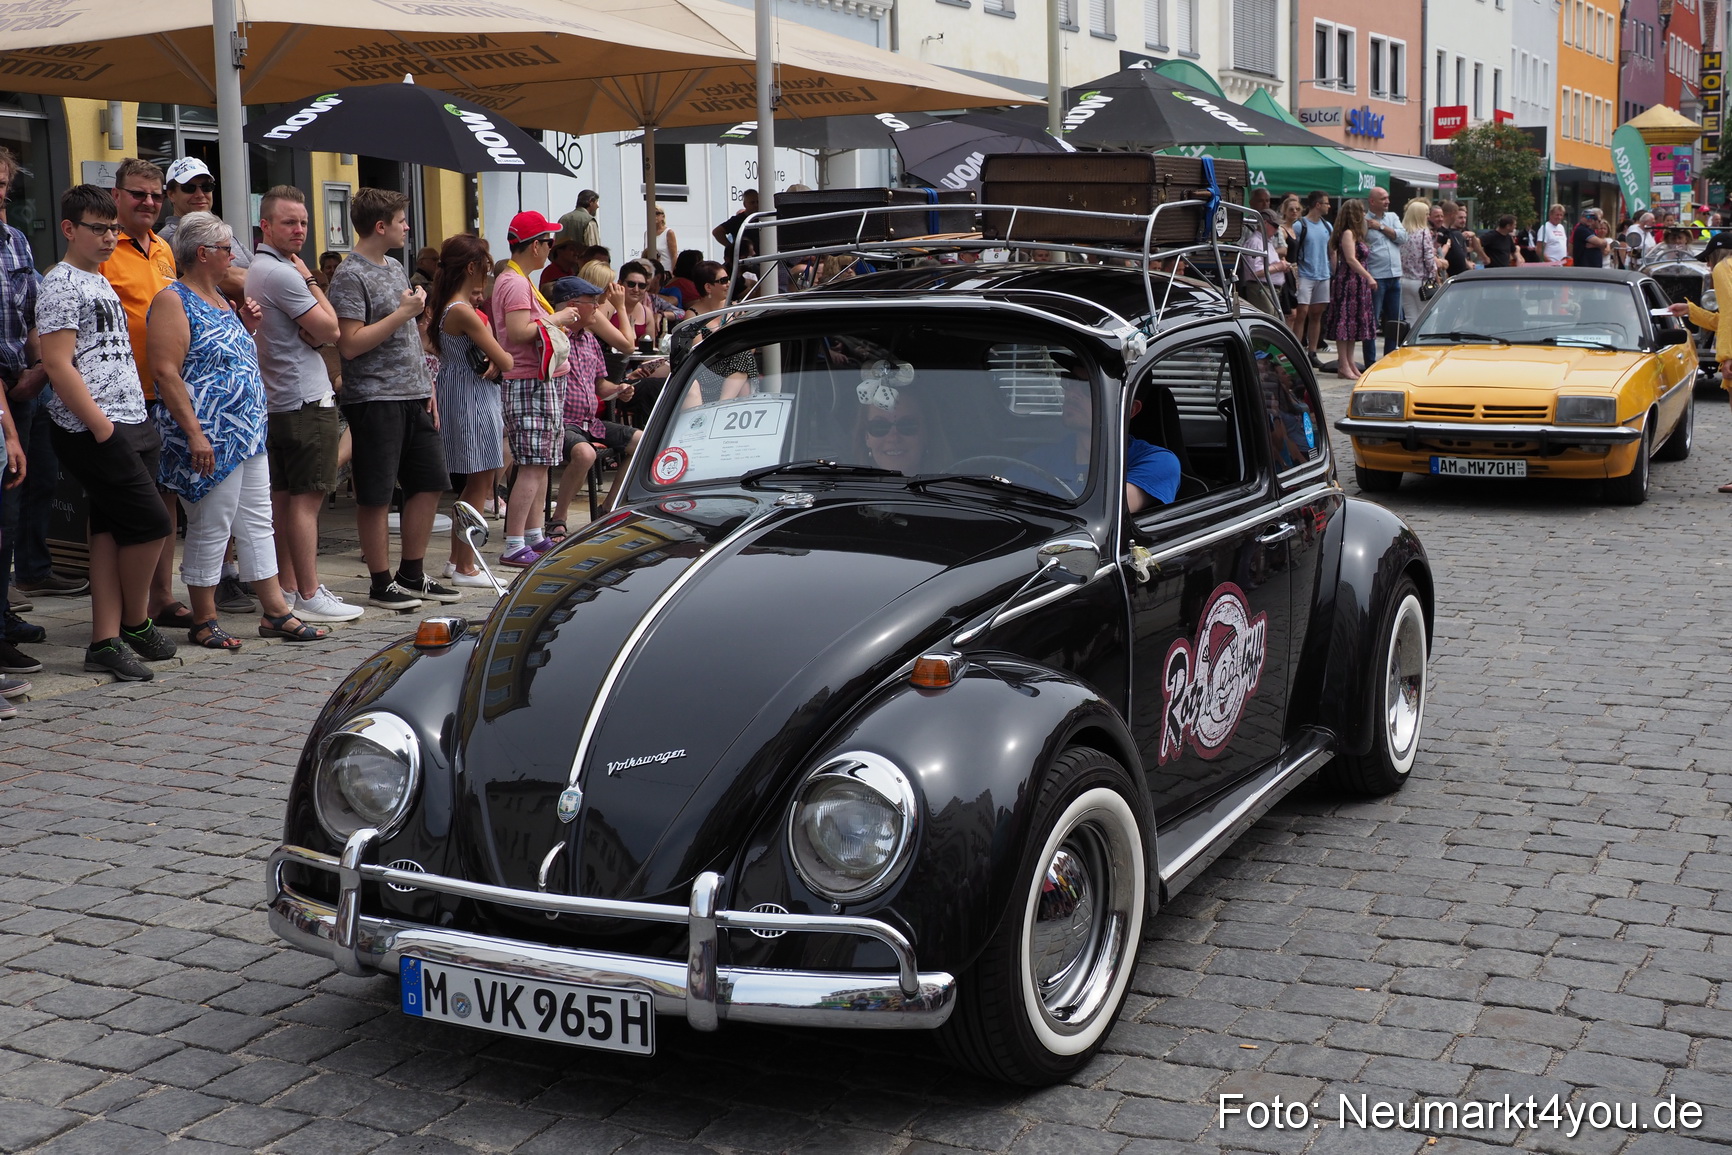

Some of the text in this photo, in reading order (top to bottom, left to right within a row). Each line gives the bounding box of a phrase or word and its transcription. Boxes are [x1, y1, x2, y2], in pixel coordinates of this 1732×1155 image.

[1702, 54, 1721, 152] HOTEL
[1438, 116, 1462, 126] WITT
[724, 409, 768, 431] 207
[1440, 459, 1458, 473] AM
[606, 748, 687, 777] Volkswagen
[408, 992, 416, 1005] D
[423, 968, 448, 1015] M
